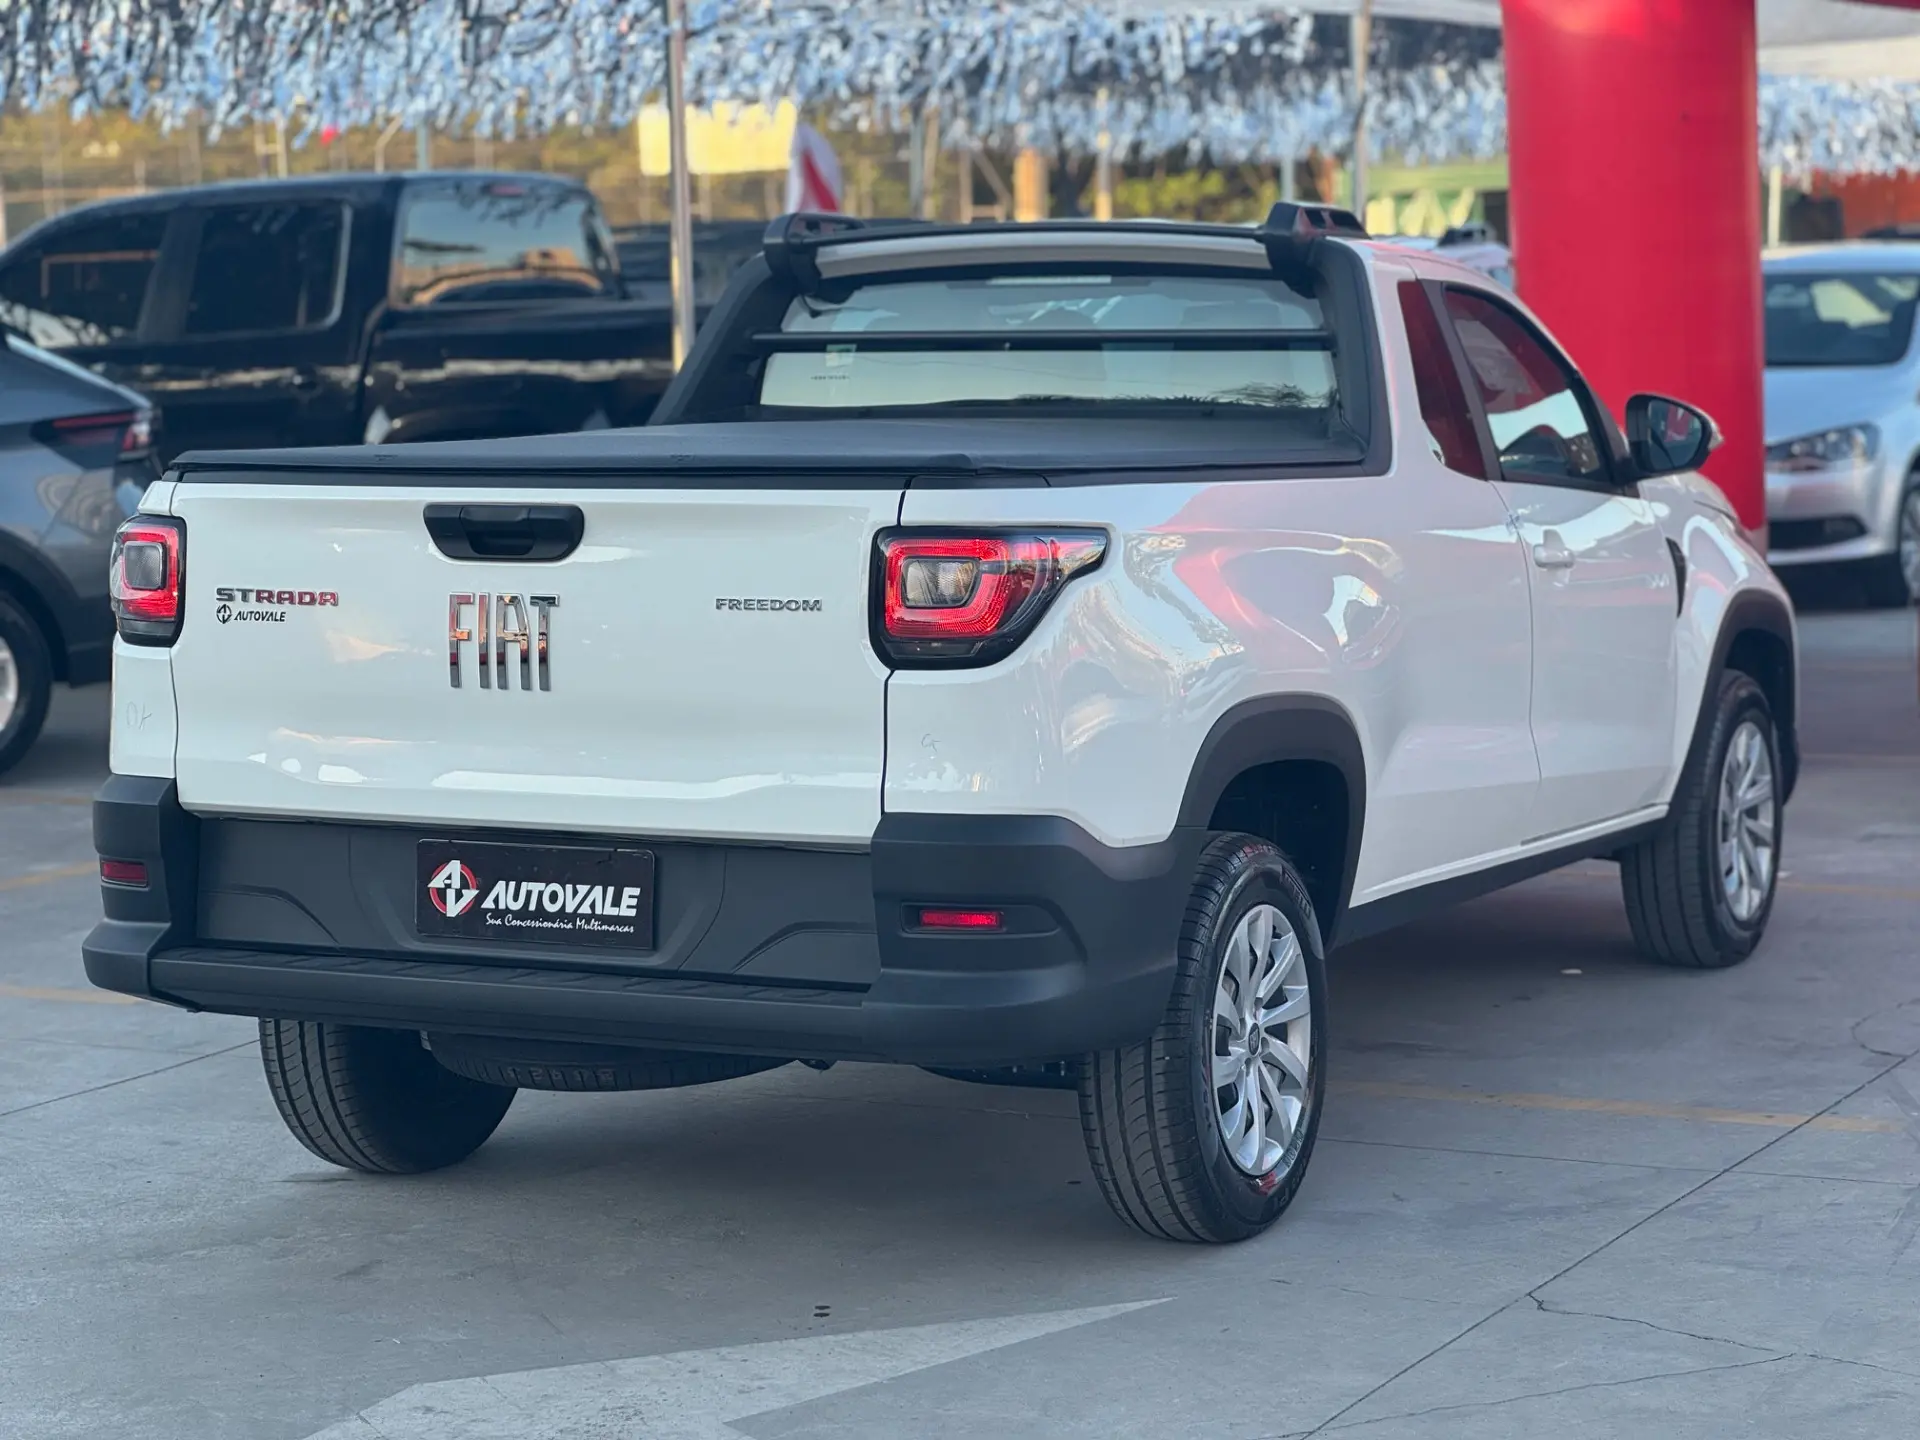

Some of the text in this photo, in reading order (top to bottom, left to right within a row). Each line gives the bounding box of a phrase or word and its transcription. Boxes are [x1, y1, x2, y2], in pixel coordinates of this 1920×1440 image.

[216, 587, 339, 606] STRADA
[715, 598, 823, 612] FREEDOM
[234, 610, 286, 622] AUTOVALE
[448, 592, 560, 691] FIAT
[480, 880, 641, 917] AUTOVALE
[486, 912, 634, 933] Sua Concessionária Multimarcas
